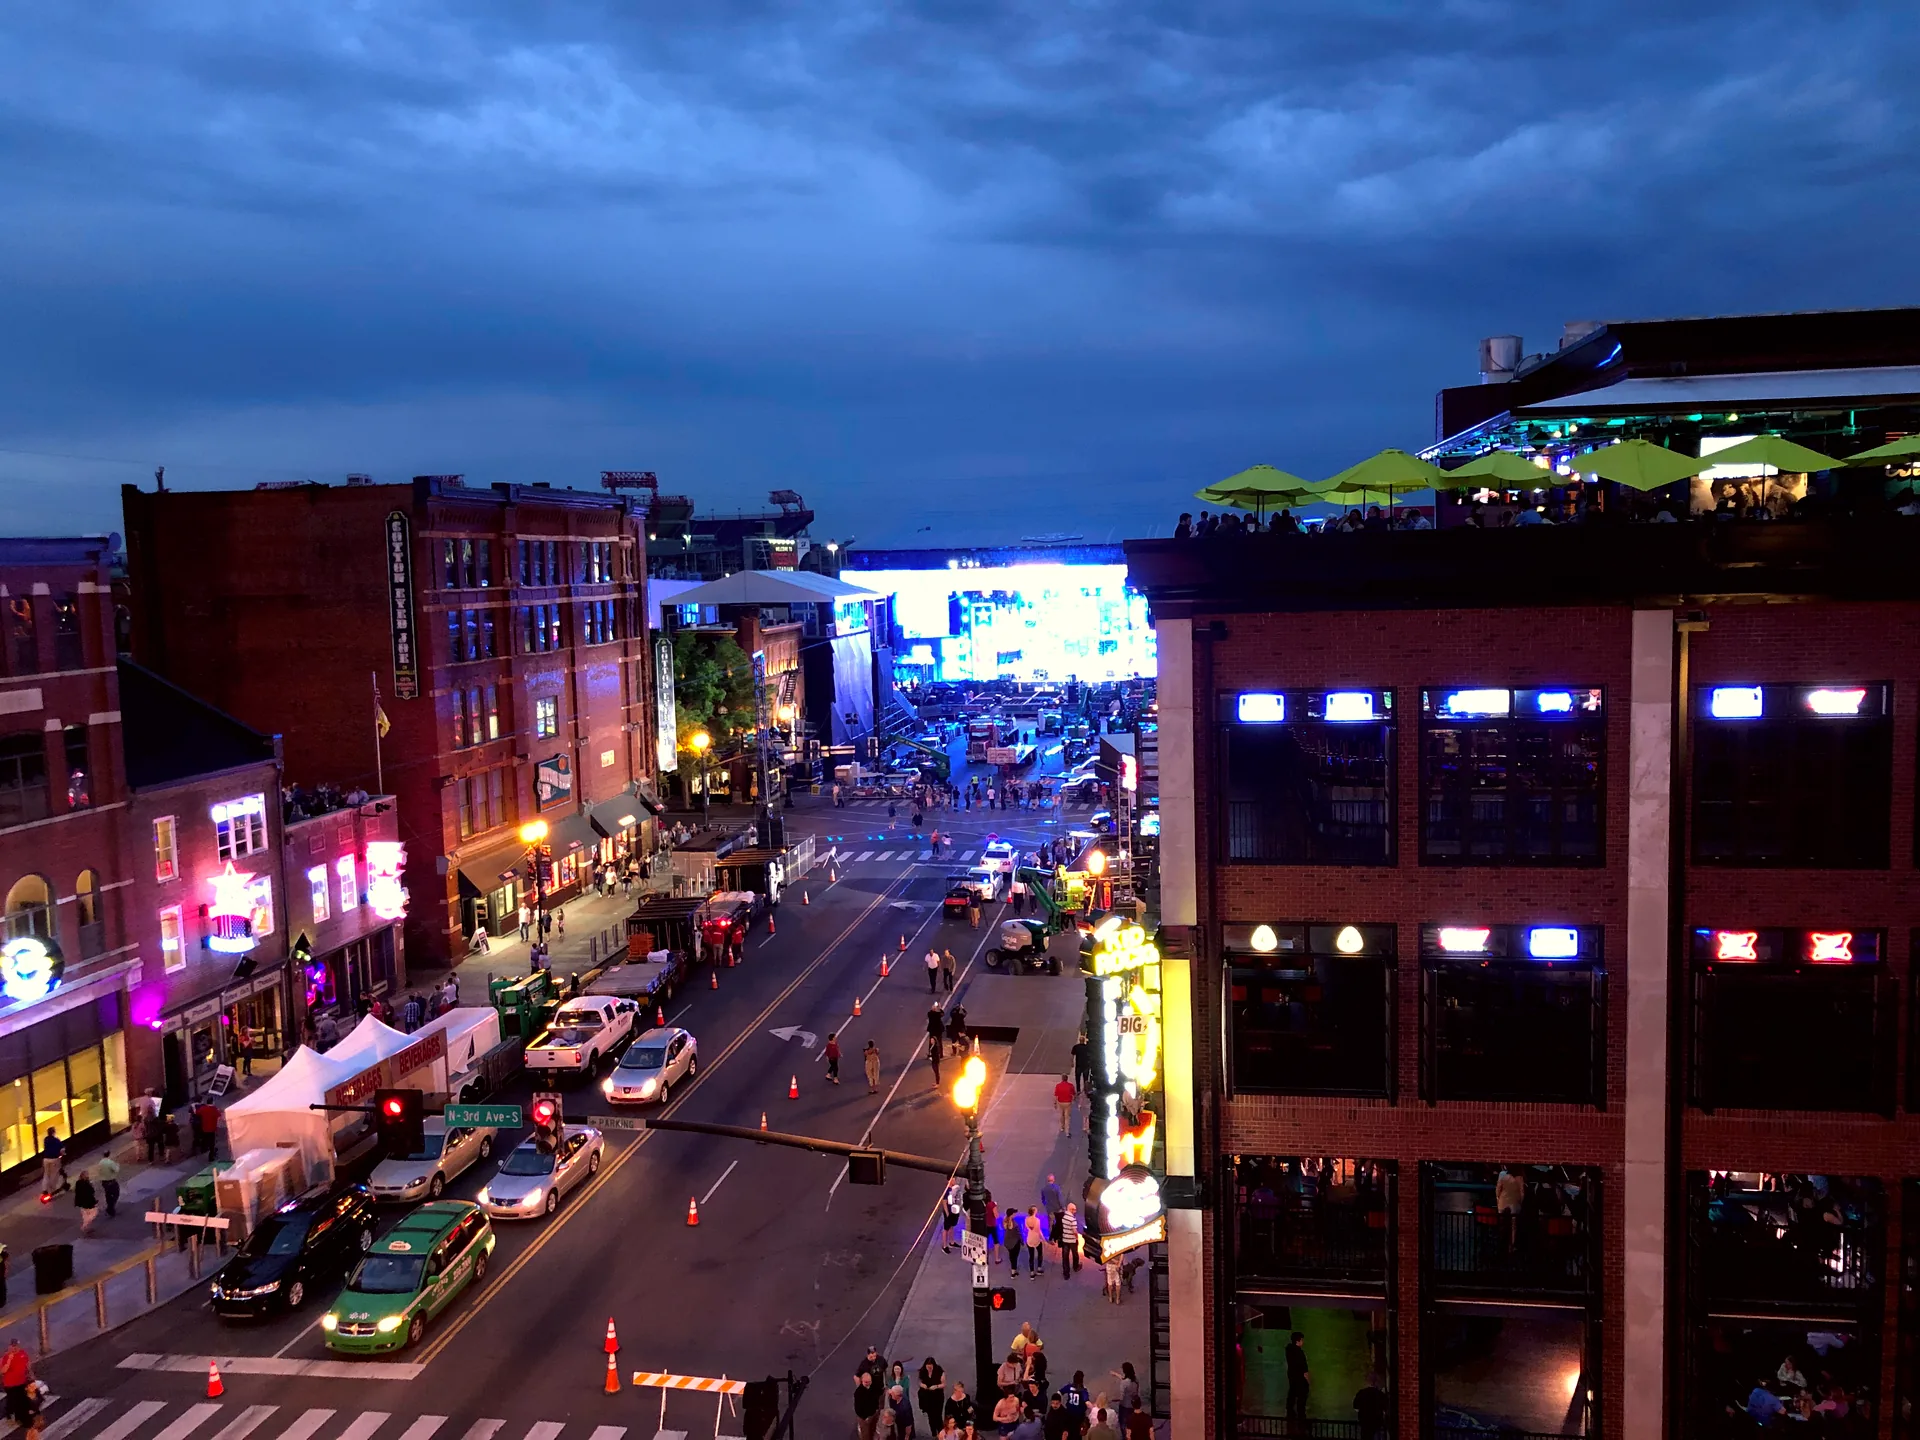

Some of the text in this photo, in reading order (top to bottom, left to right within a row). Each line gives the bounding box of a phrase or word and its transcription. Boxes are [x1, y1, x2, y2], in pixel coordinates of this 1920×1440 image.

[392, 521, 405, 583] COTTON
[395, 588, 408, 629] EYED
[398, 633, 410, 664] JOE
[661, 645, 669, 689] COTTON
[1119, 1015, 1142, 1034] BIG
[400, 1035, 440, 1076] BEVERAGES
[599, 1118, 634, 1129] PARKING
[962, 1244, 973, 1258] OK
[1069, 1392, 1080, 1406] 10
